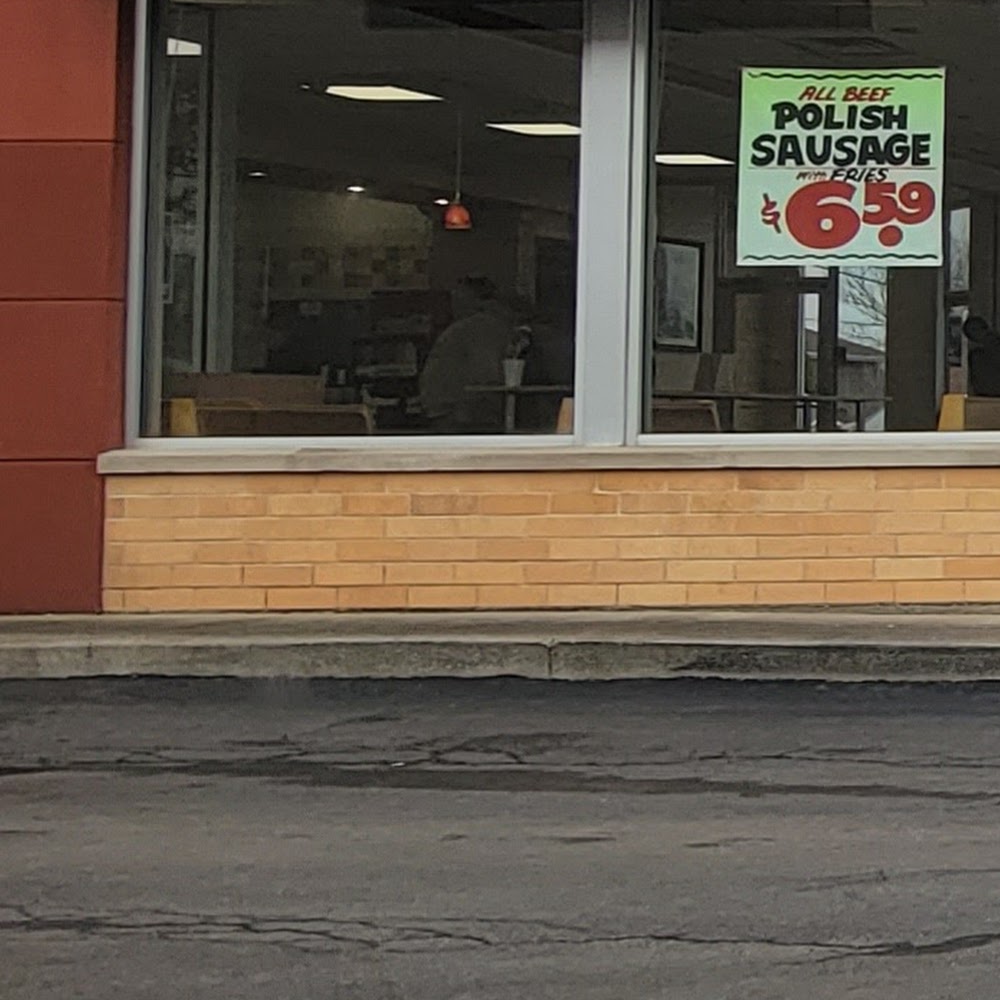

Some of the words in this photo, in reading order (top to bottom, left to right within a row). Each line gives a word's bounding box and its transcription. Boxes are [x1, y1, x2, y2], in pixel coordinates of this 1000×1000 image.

[798, 86, 837, 101] ALL
[842, 86, 895, 102] BEEF
[771, 102, 908, 130] POLISH
[750, 133, 931, 167] SAUSAGE
[830, 167, 889, 183] FRIES
